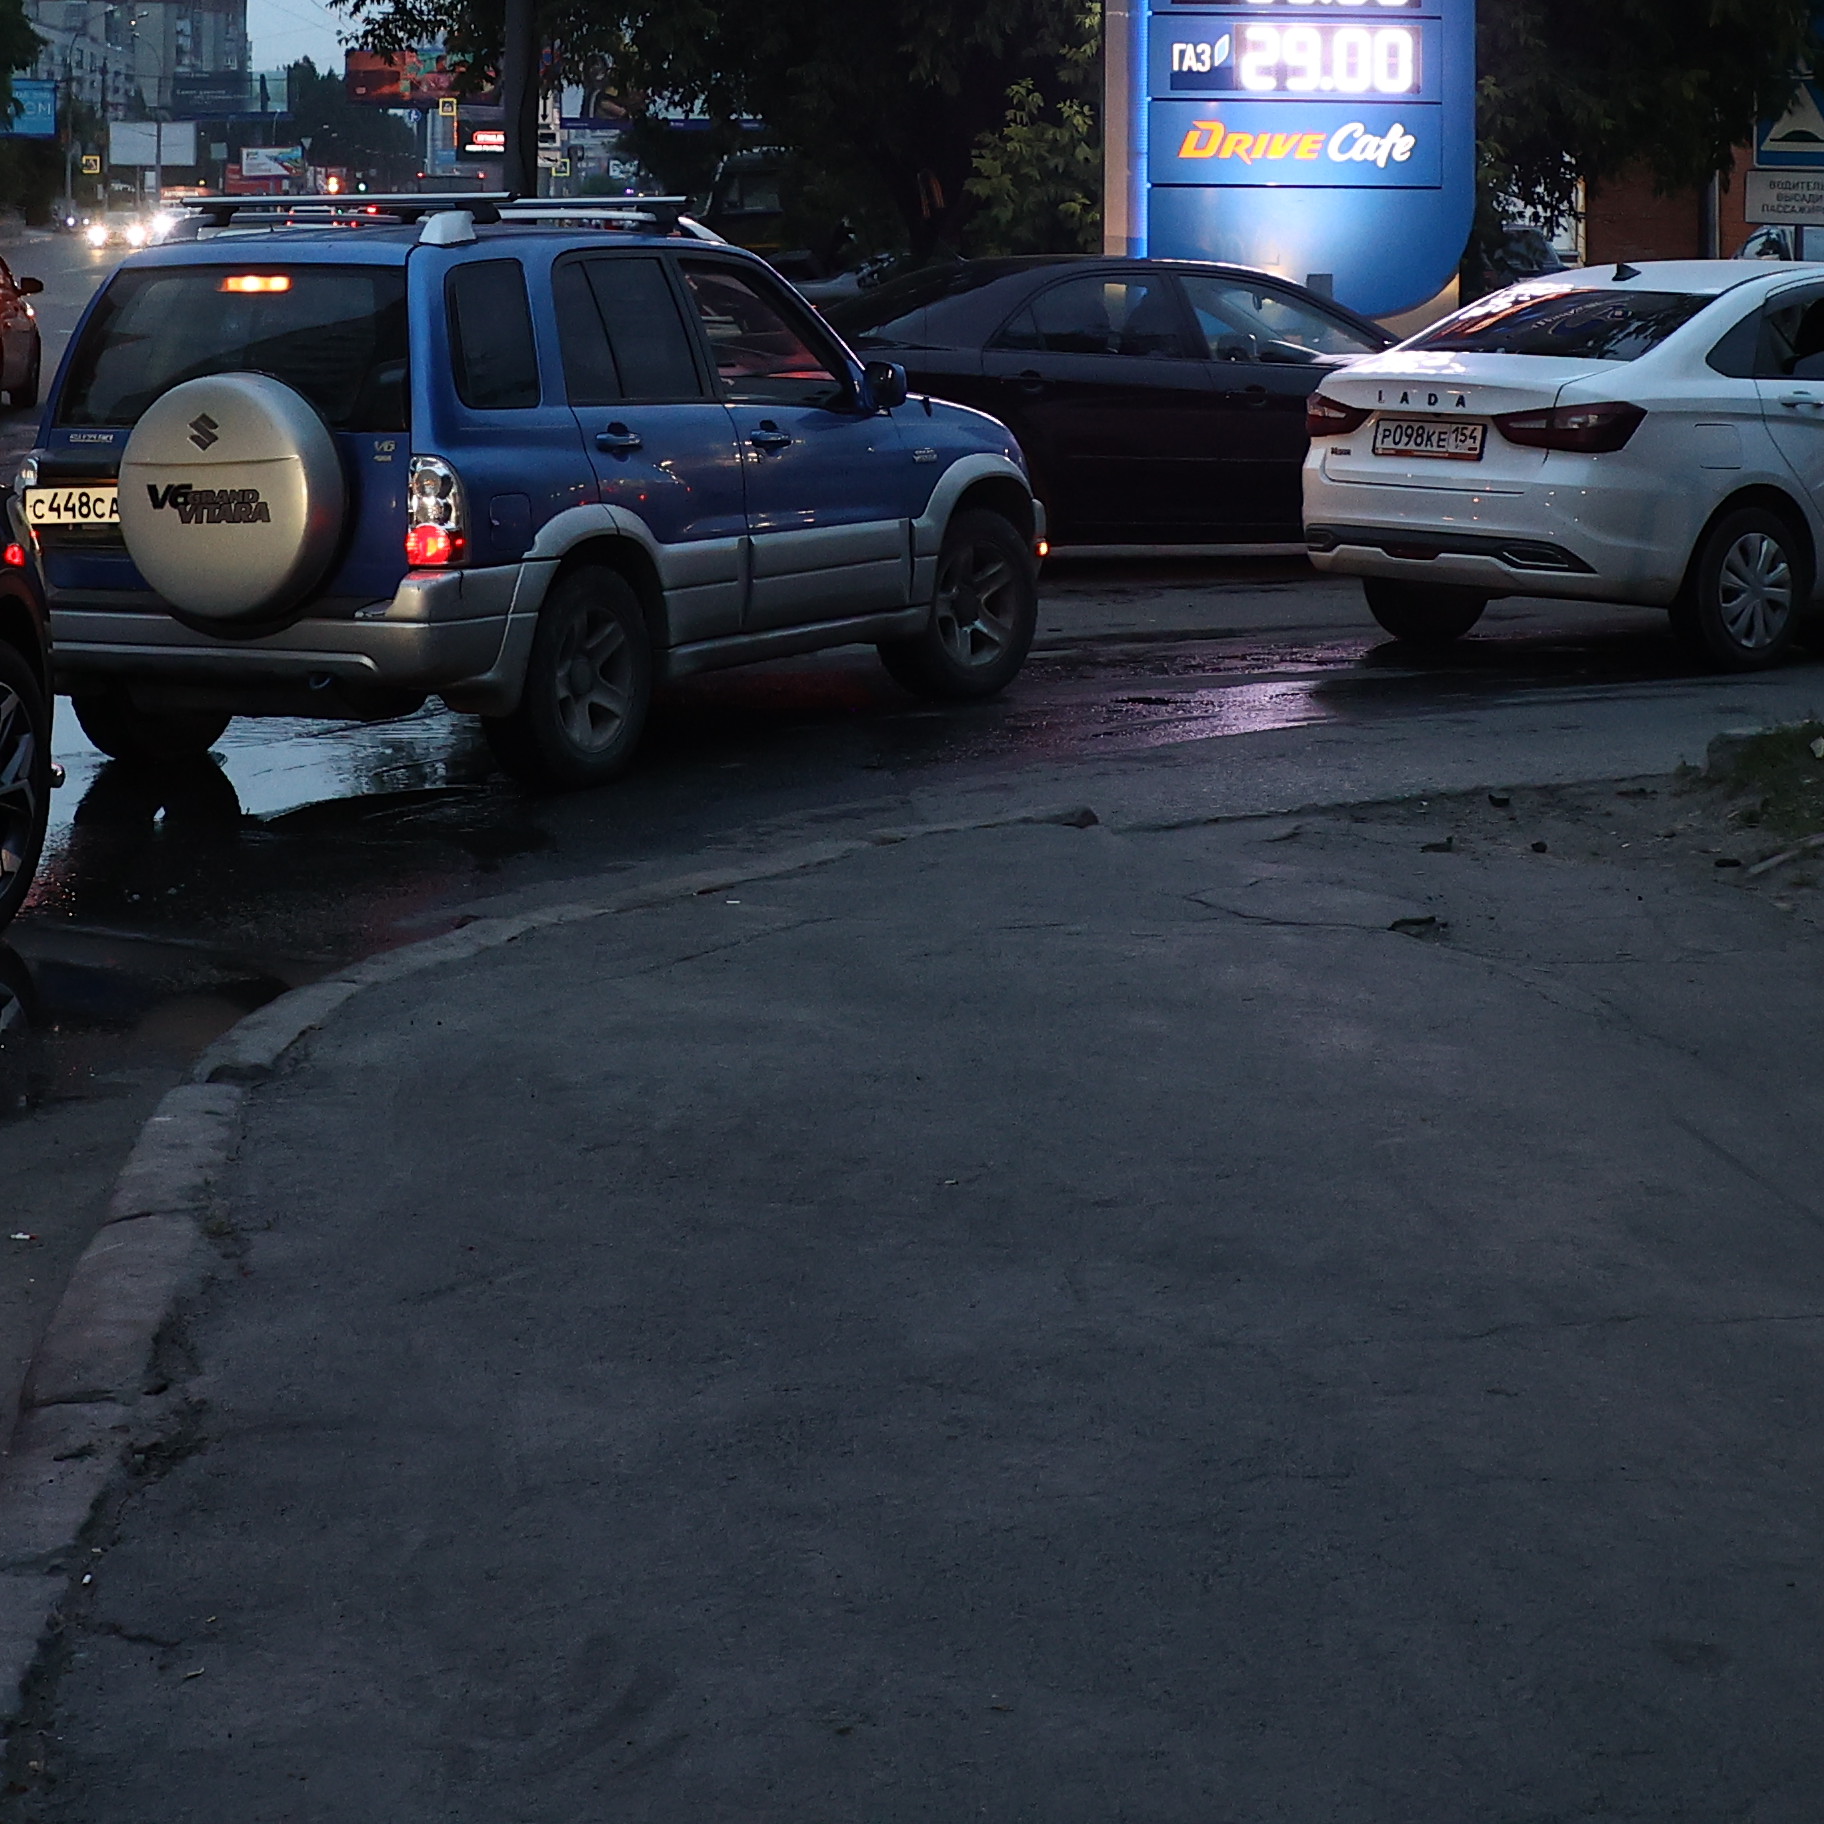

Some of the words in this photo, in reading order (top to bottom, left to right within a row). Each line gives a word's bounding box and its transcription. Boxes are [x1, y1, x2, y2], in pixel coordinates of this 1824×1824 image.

[1173, 43, 1211, 72] ГАЗ
[1240, 28, 1414, 94] 29.00
[1178, 120, 1326, 165] DRIVE
[1327, 122, 1416, 168] Cafe
[1378, 390, 1466, 408] LADA
[1451, 426, 1478, 444] 154
[147, 483, 193, 510] V6
[188, 489, 260, 504] GRAND
[177, 501, 271, 524] VITARA
